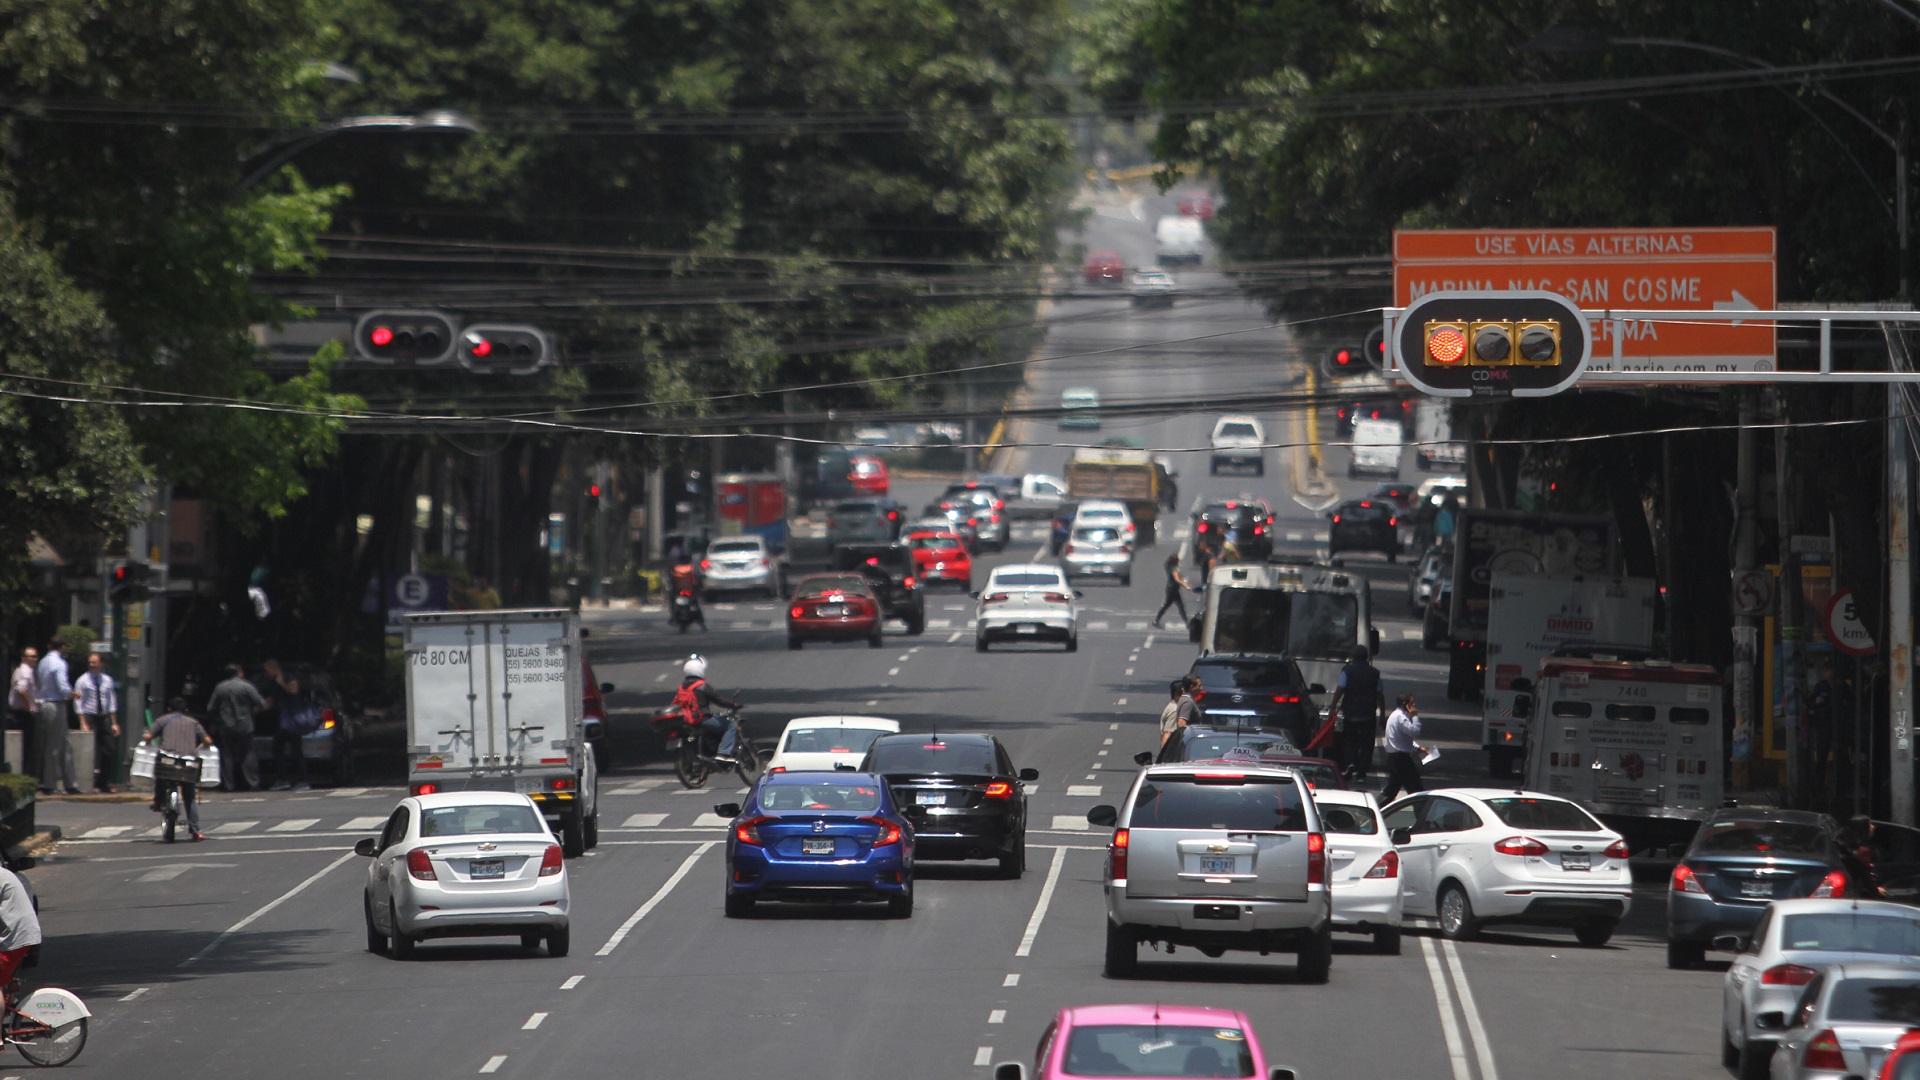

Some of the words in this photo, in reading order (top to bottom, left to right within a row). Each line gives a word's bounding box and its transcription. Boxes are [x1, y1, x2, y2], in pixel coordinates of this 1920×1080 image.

[1475, 237, 1517, 255] USE
[1526, 233, 1576, 254] VÍAS
[1586, 234, 1694, 255] ALTERNAS
[1622, 278, 1702, 302] COSME
[1471, 370, 1509, 381] CDMX
[1546, 618, 1594, 632] BIMBO
[431, 651, 446, 665] 80
[449, 650, 469, 665] CM
[506, 648, 540, 658] QUEJAS
[1274, 744, 1293, 753] TAXI
